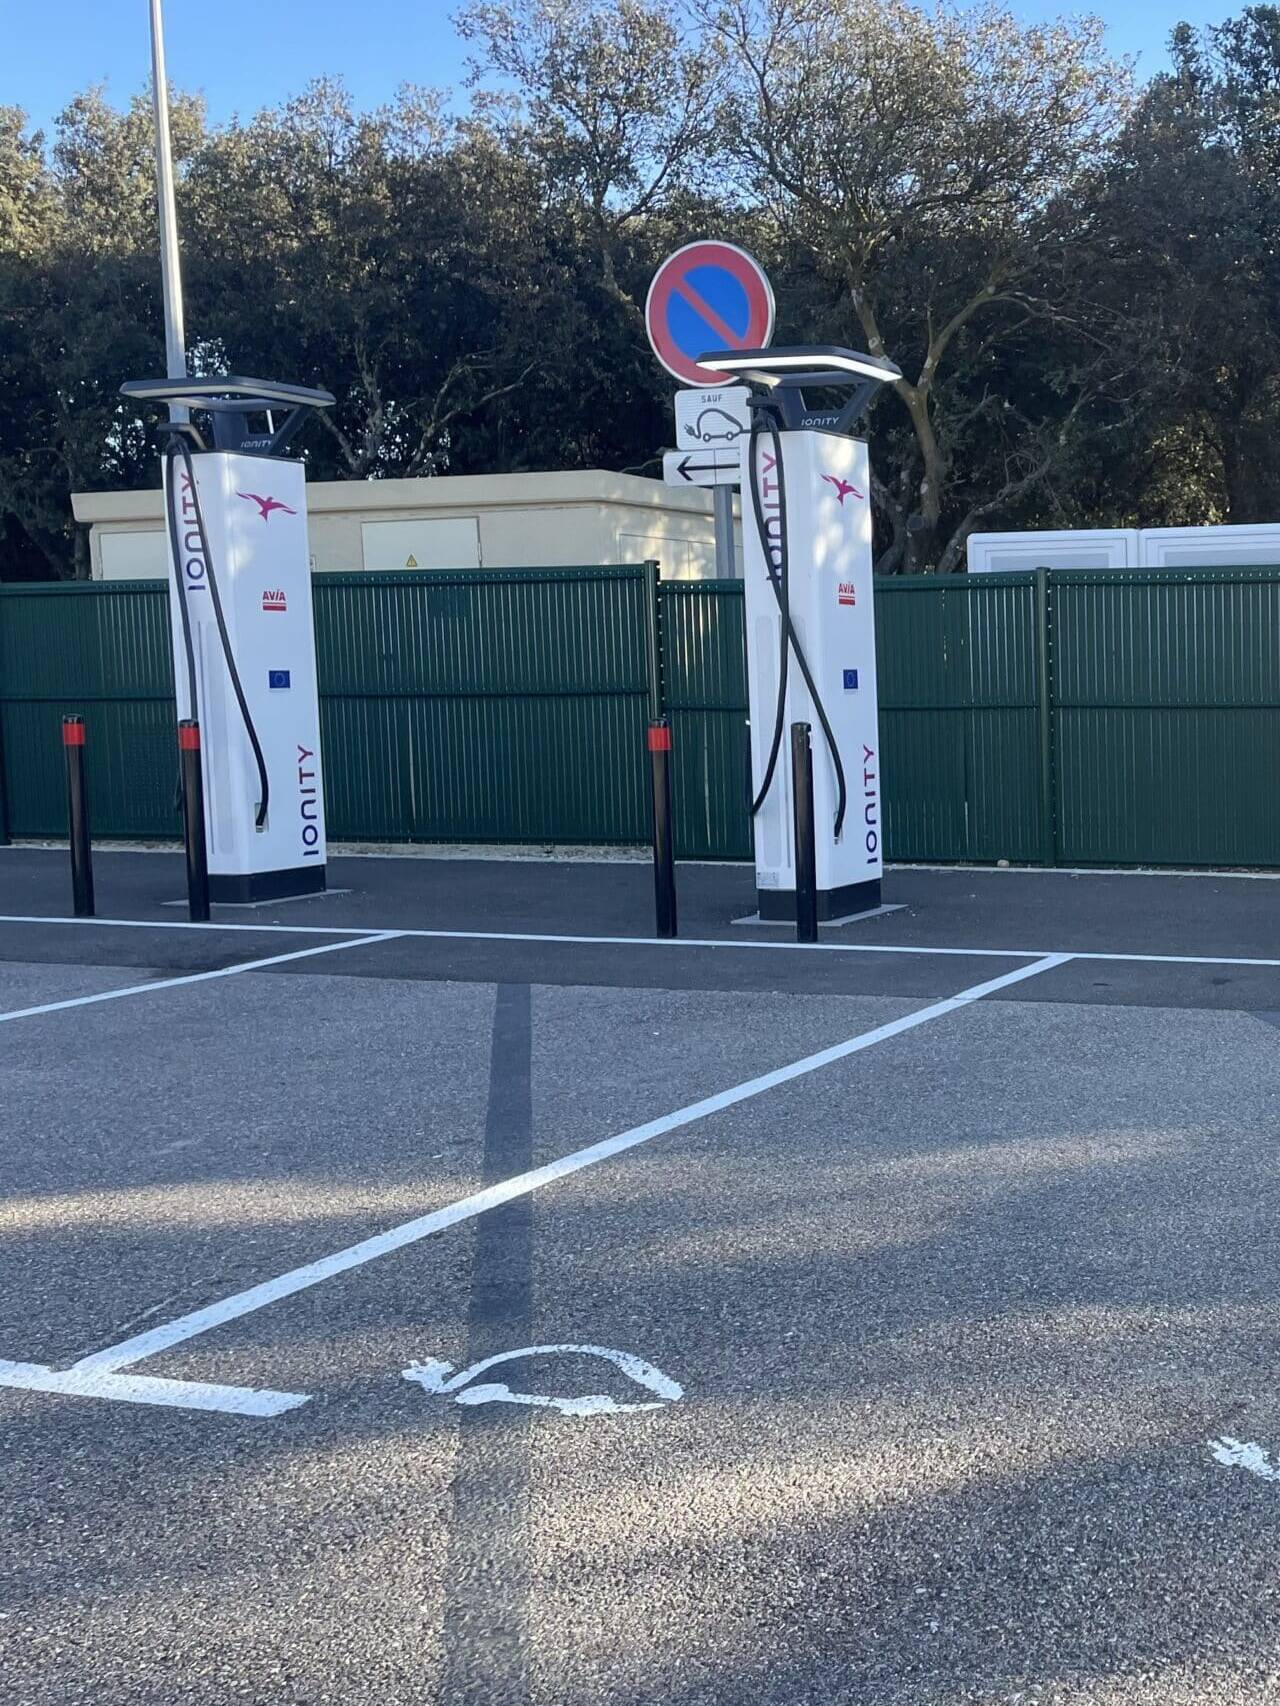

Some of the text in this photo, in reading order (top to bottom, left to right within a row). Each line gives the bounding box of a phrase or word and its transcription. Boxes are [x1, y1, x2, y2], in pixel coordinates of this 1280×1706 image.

[701, 394, 722, 403] SAUF
[801, 416, 839, 426] IONITY
[241, 440, 271, 448] IONITY
[181, 473, 206, 590] IONITY
[298, 745, 319, 856] IONITY
[864, 744, 878, 864] IONITY
